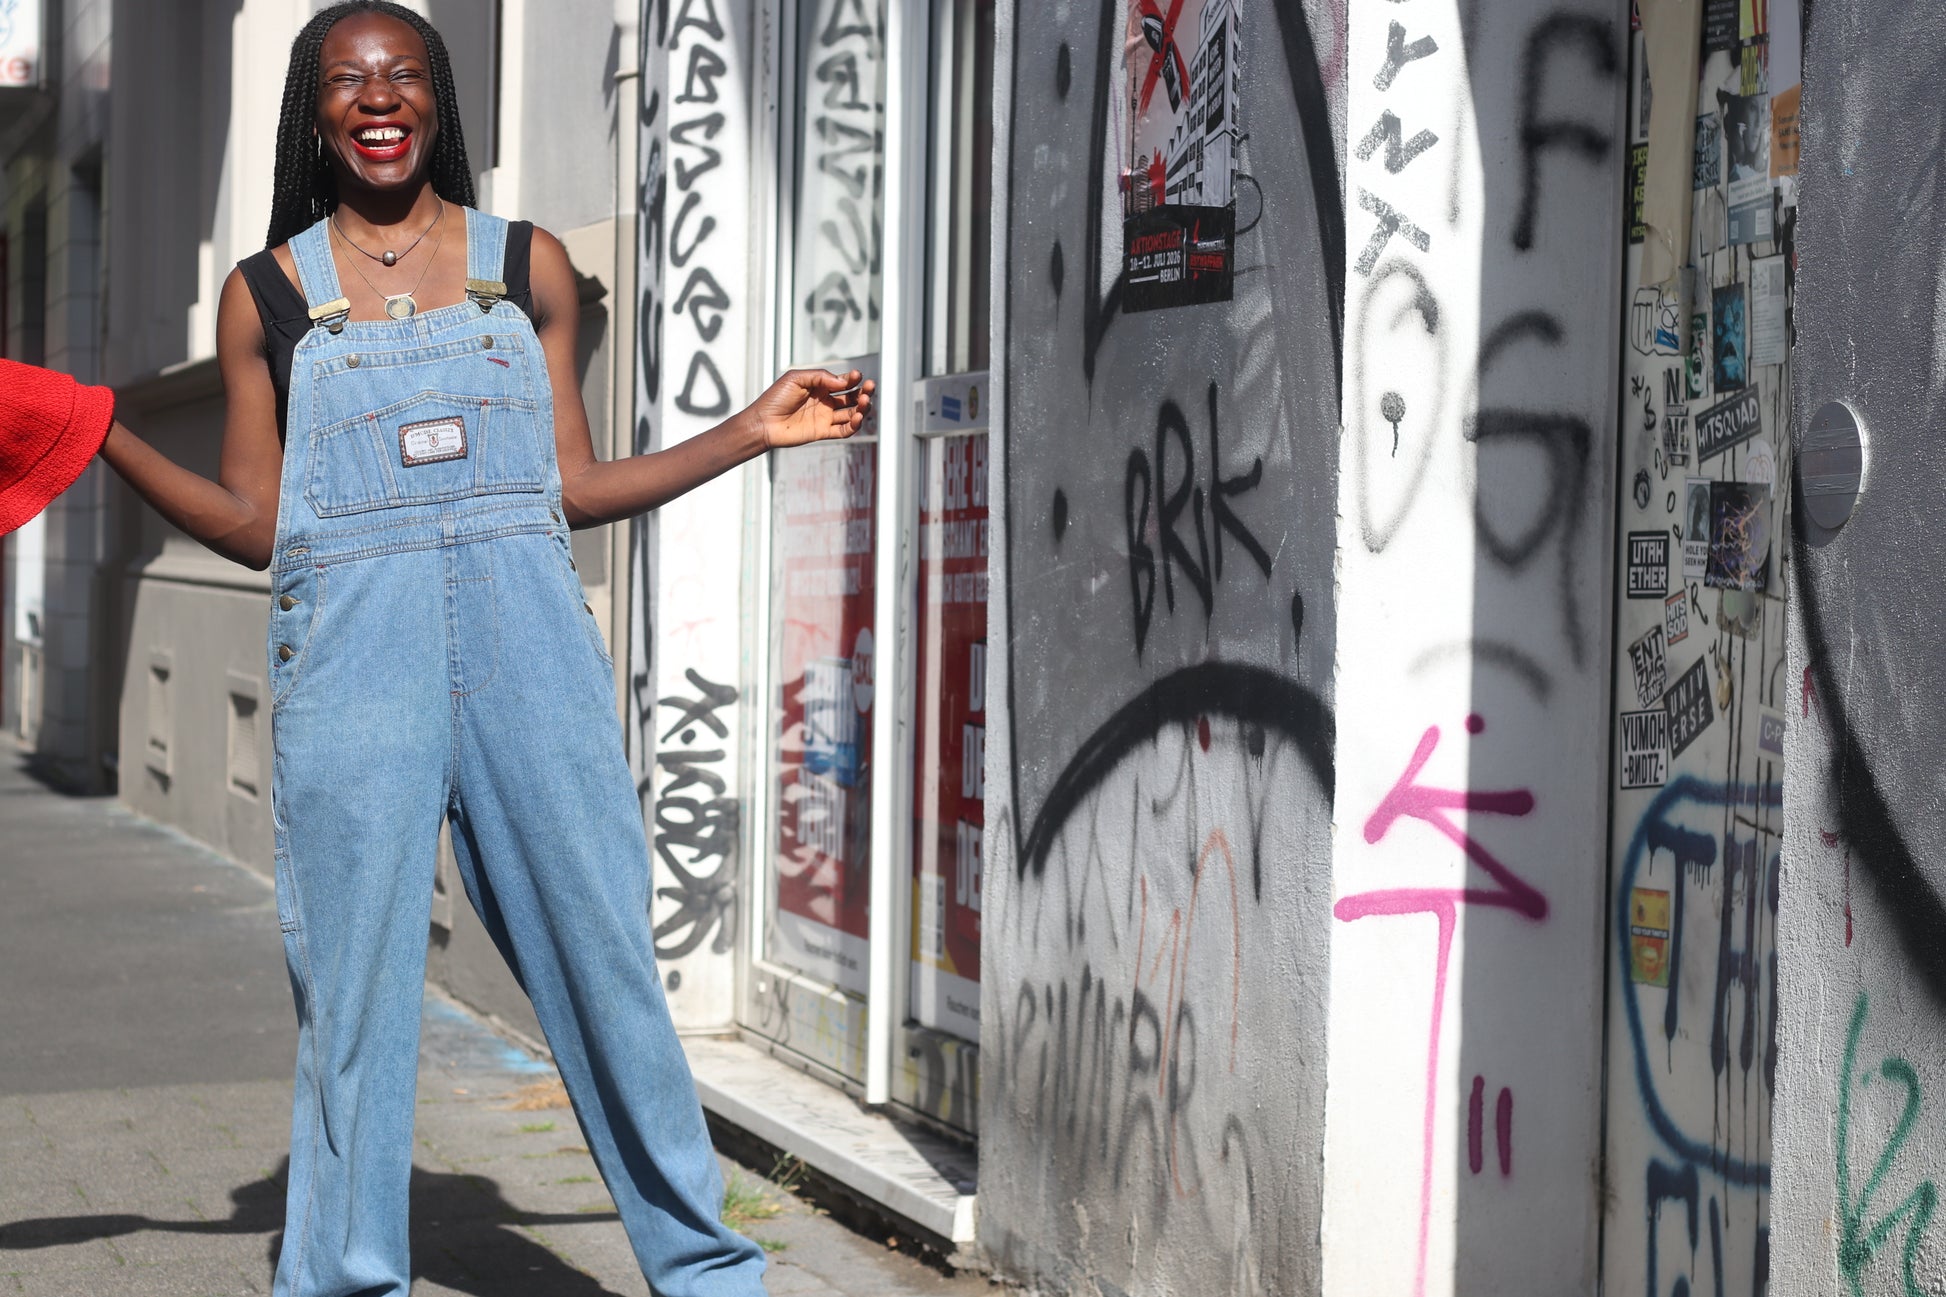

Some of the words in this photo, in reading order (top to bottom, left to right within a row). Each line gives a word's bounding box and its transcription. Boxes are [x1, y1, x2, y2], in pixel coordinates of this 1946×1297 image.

[669, 0, 731, 417] ABSURD
[1130, 230, 1181, 256] AKTIONSTAGE
[1153, 252, 1166, 268] JULI
[1166, 250, 1181, 265] 2026
[1159, 267, 1181, 283] BERLIN
[1697, 397, 1759, 449] HITSQUAD
[1632, 541, 1664, 563] UTAH
[1700, 545, 1708, 557] YO
[1629, 566, 1667, 589] ETHER
[1666, 598, 1686, 622] HITS
[1633, 633, 1660, 671] ENT
[1670, 663, 1705, 717] UNIV
[1622, 713, 1666, 753] YUMOH
[1672, 697, 1706, 750] ERSE
